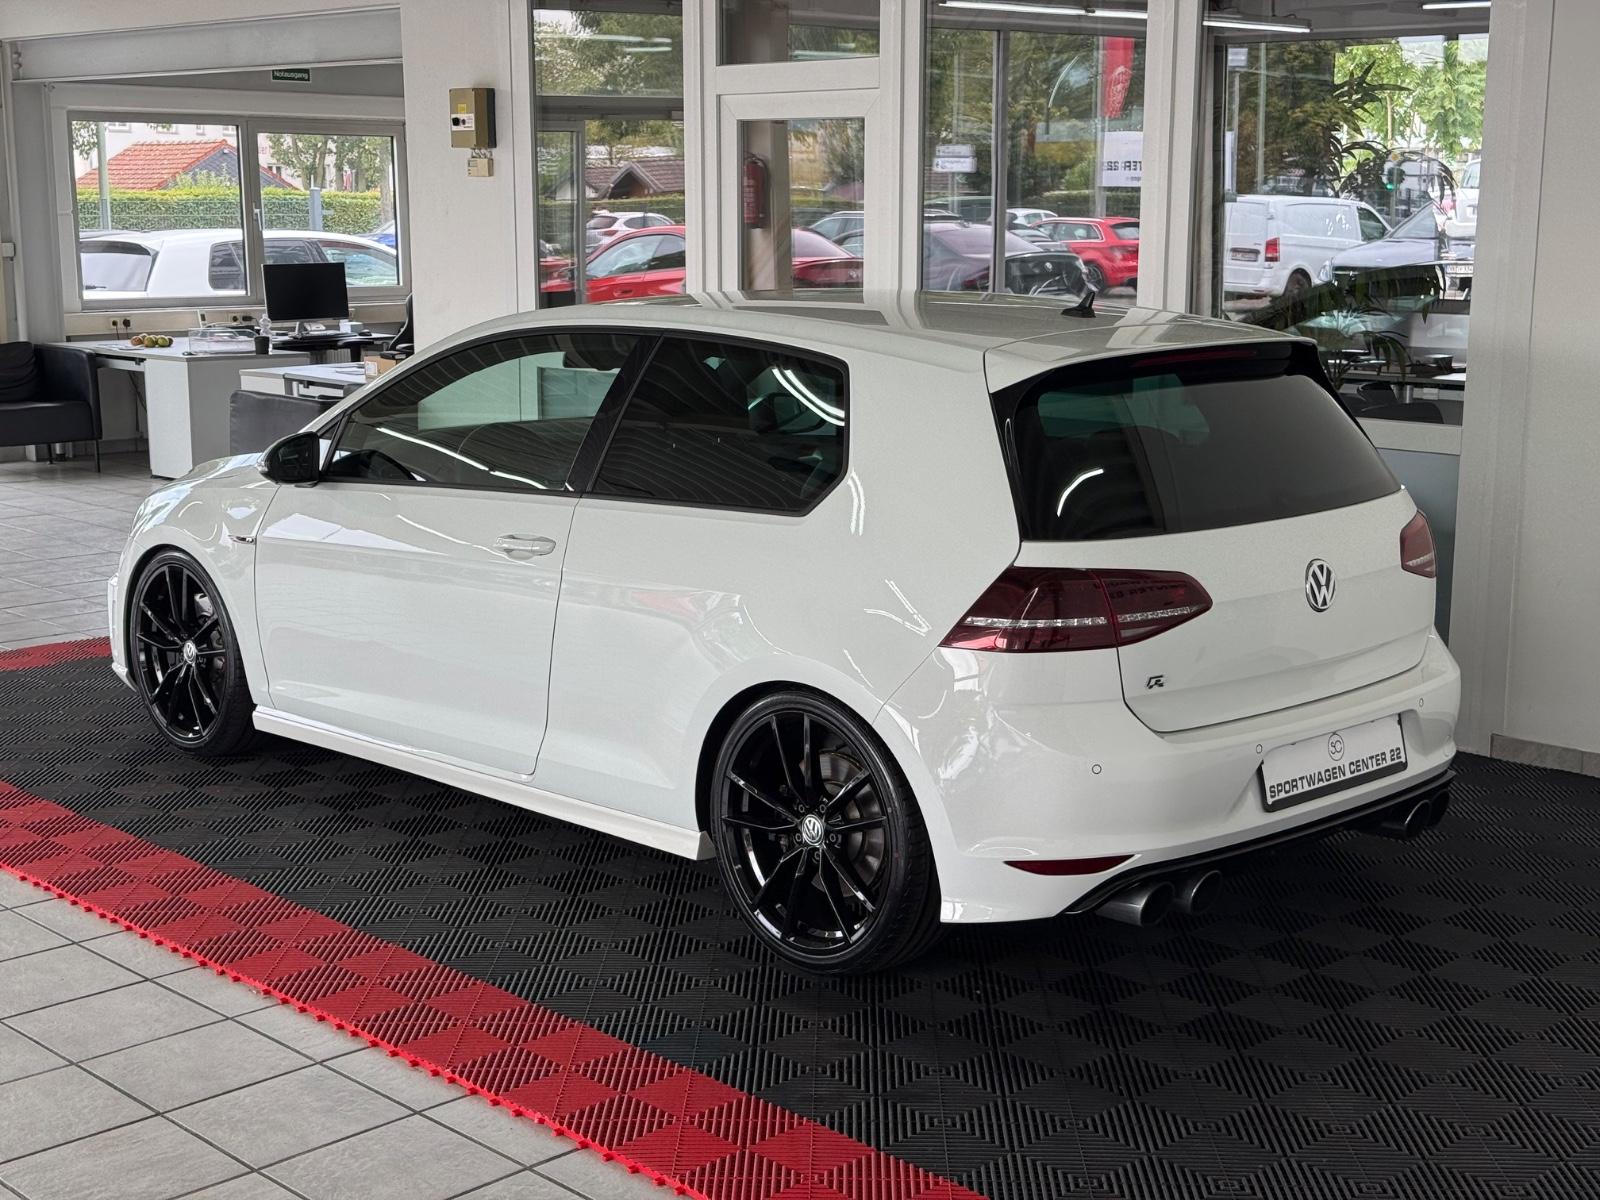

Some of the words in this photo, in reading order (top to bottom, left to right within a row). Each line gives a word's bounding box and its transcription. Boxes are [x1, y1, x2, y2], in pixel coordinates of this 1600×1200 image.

[273, 70, 309, 80] Notausgang
[1147, 675, 1164, 690] R
[1269, 765, 1346, 798] SPORTWAGEN
[1348, 751, 1388, 775] CENTER
[1389, 747, 1402, 762] 22
